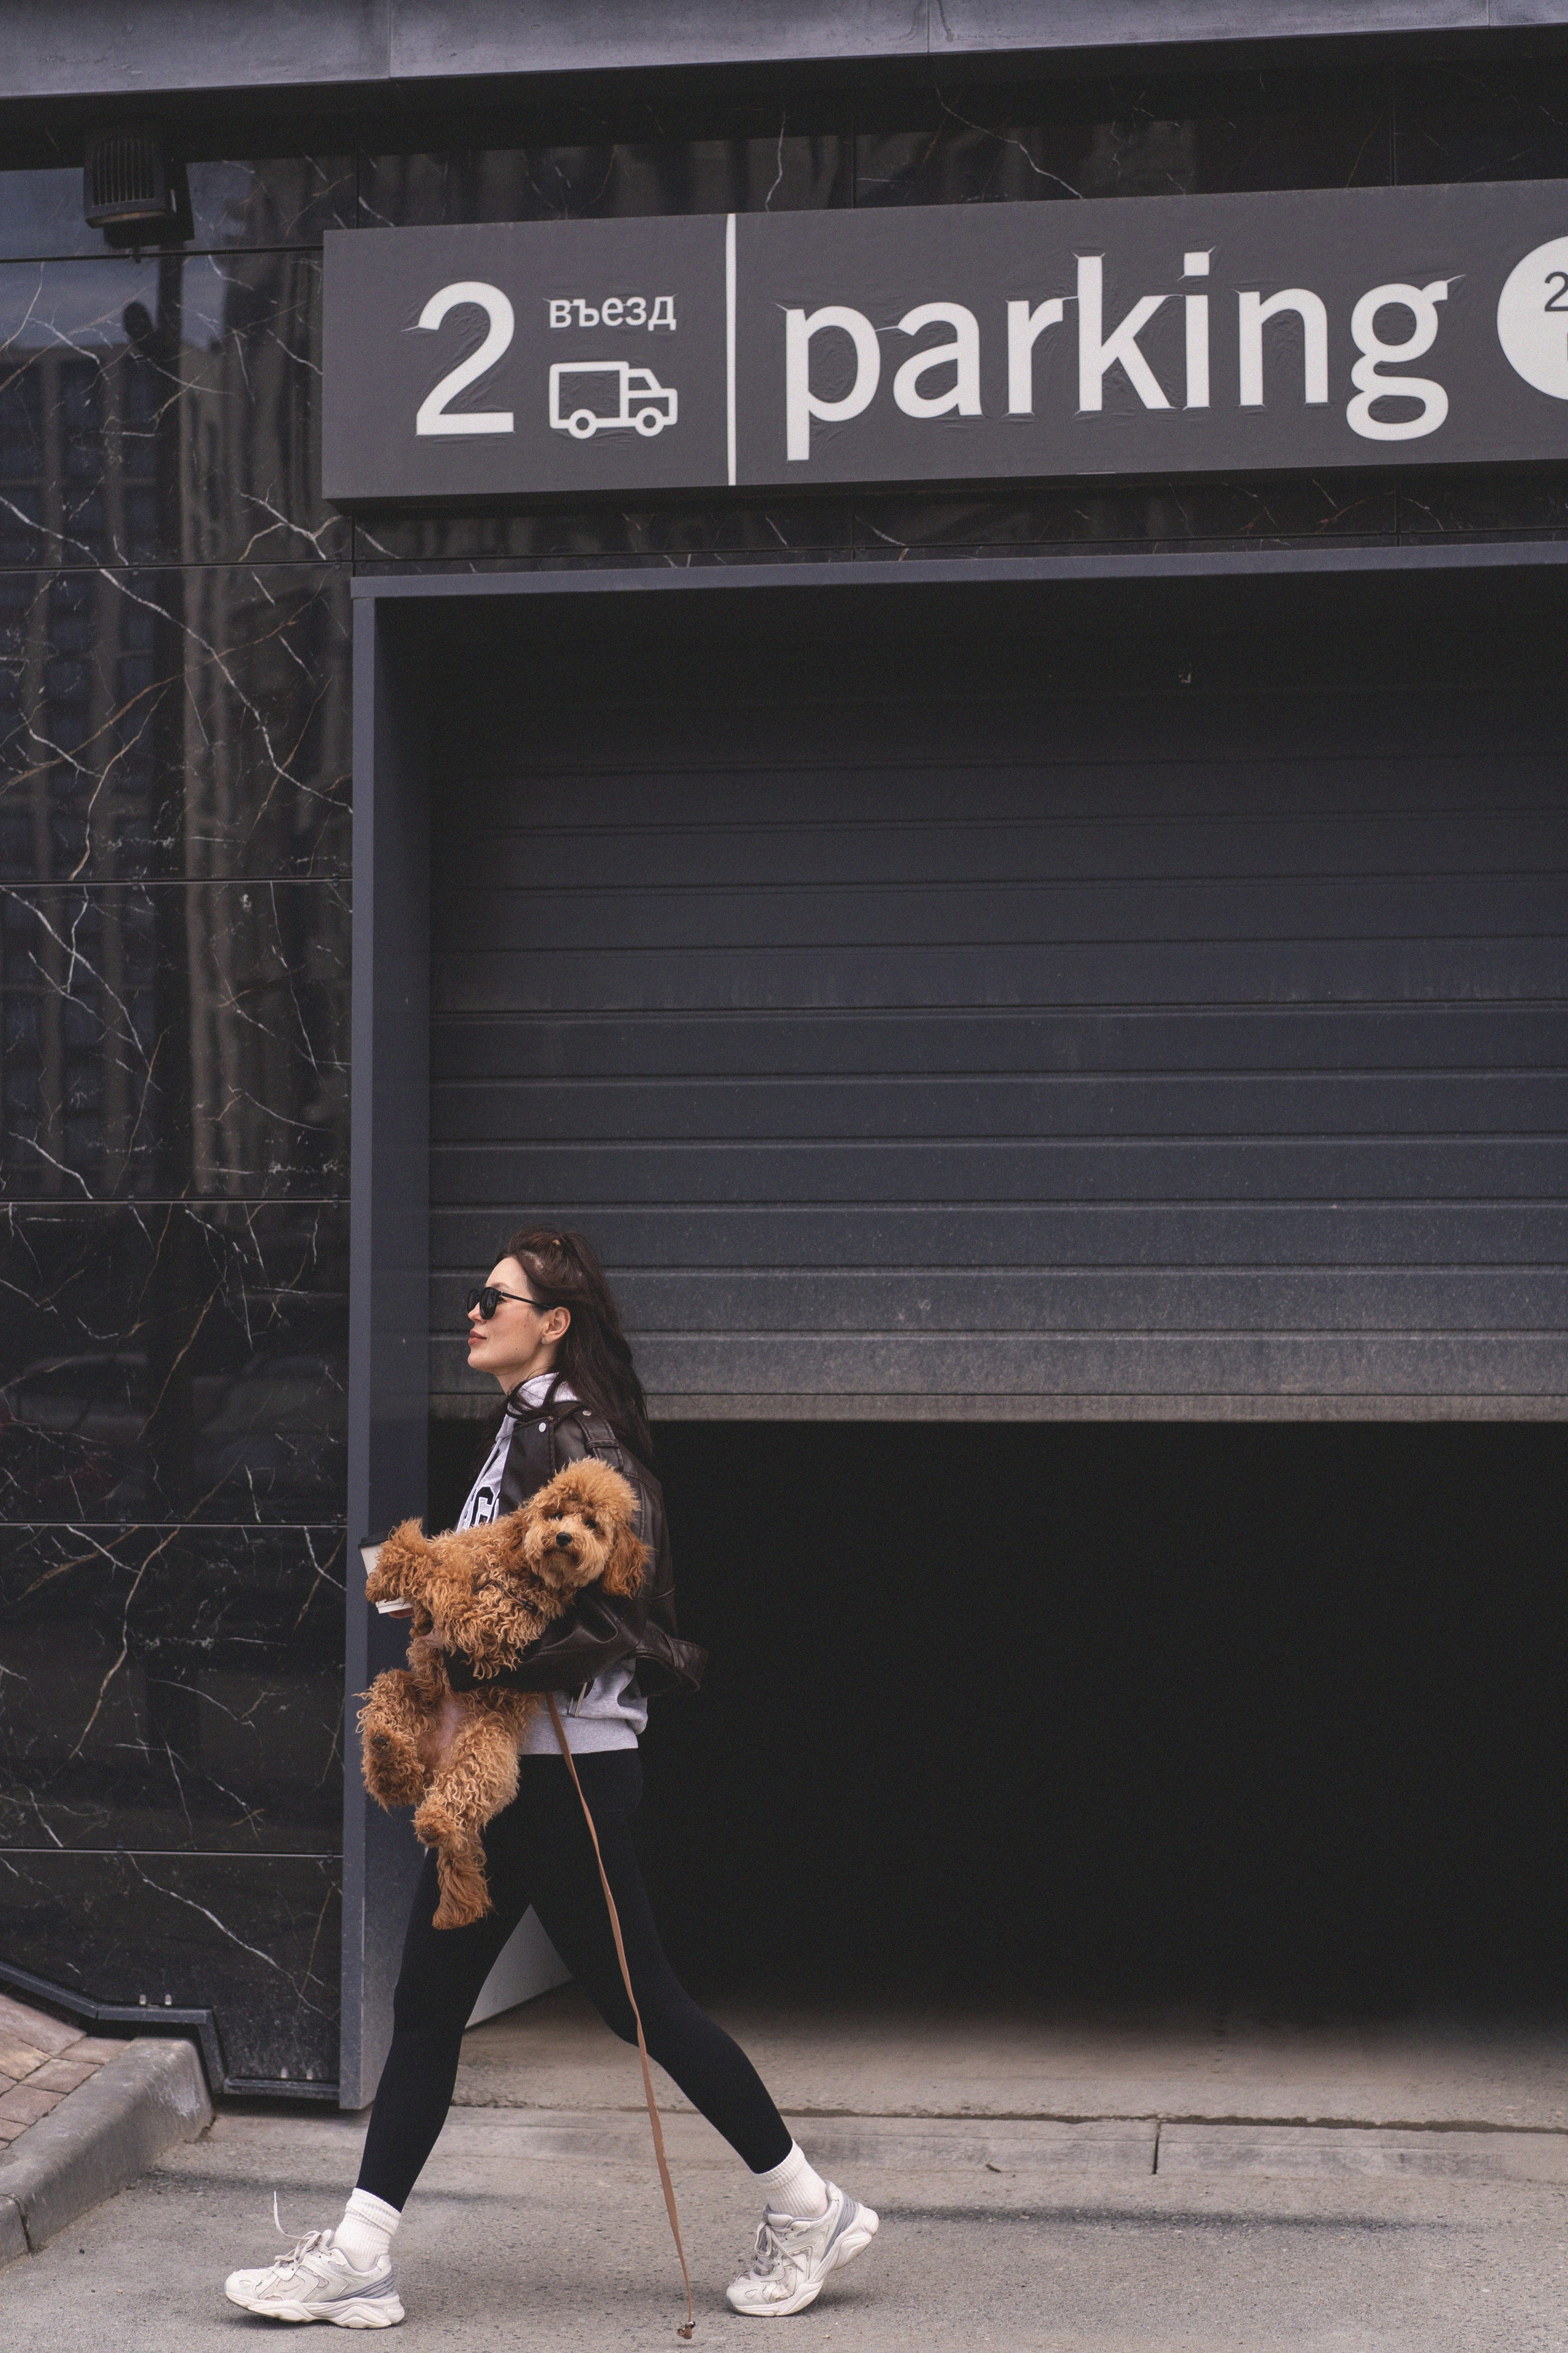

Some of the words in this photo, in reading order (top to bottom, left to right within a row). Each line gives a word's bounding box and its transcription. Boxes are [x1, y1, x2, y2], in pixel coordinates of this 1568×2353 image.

[415, 281, 514, 436] 2
[549, 296, 677, 331] въезд
[785, 252, 1449, 461] parking
